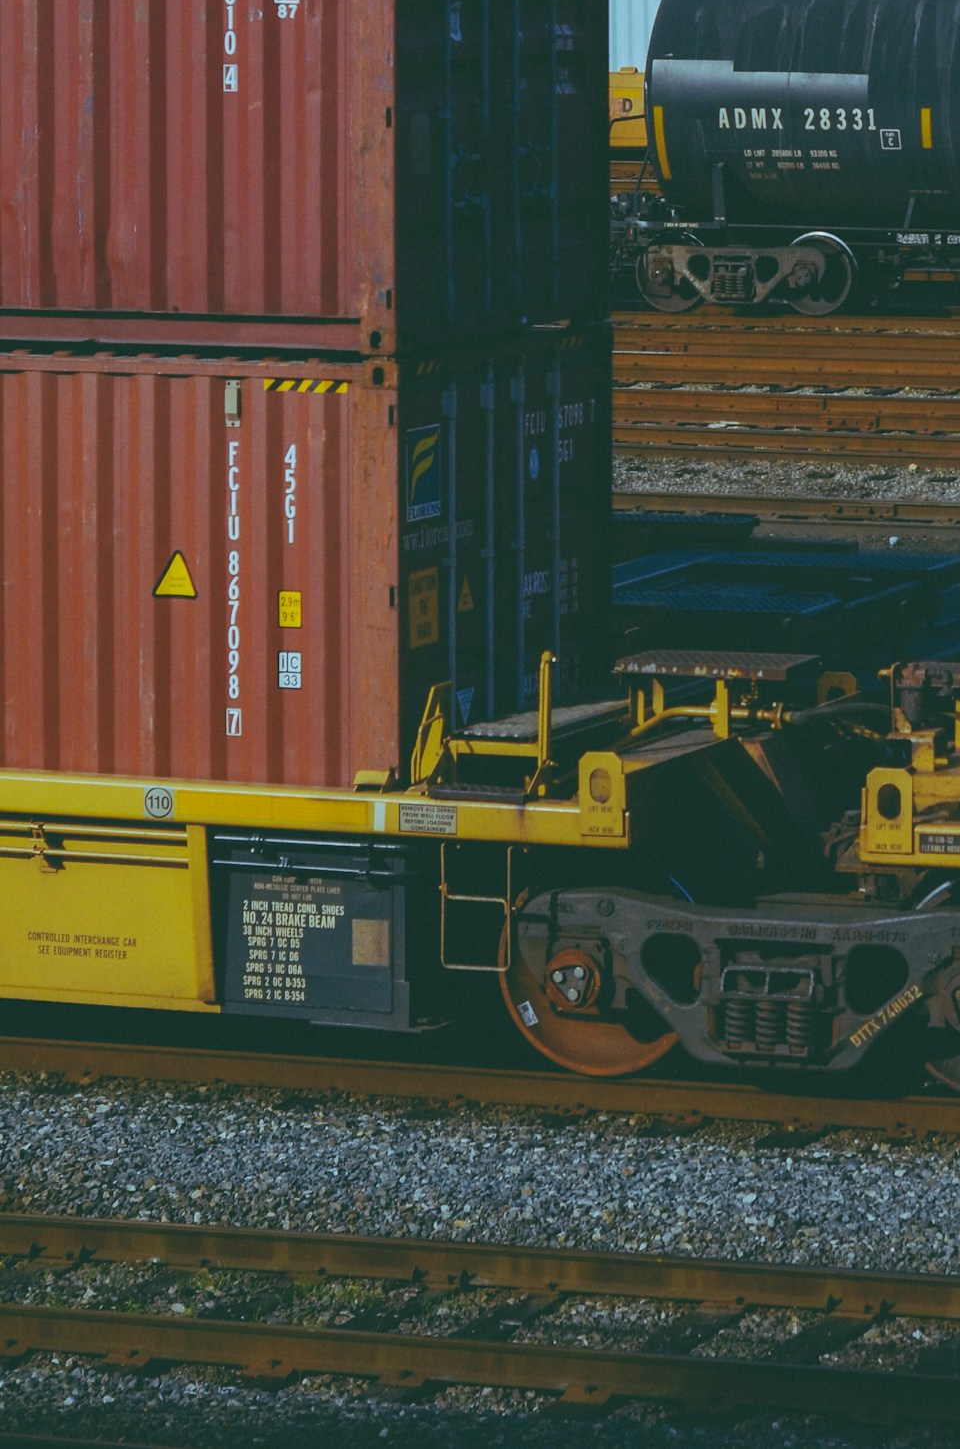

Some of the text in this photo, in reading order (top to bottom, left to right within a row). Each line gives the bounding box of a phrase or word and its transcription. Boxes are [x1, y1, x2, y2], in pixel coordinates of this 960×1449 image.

[277, 4, 297, 19] 87
[224, 65, 237, 91] 4
[622, 98, 633, 112] D
[718, 107, 877, 131] ADMX 28331
[888, 137, 894, 146] C
[558, 438, 573, 463] 5G1
[284, 444, 297, 543] 45G1
[228, 441, 240, 735] FCIU 867098 7
[283, 674, 298, 687] 33
[148, 795, 170, 810] 110
[243, 900, 344, 916] 2 INCH TREAD COND. SHOES
[243, 911, 335, 929] NO. 24 BRAKE BEAM
[243, 925, 304, 938] 38 INCH WHEELS
[28, 931, 136, 947] CONTROLLED INTERCHANGE CAR
[248, 937, 266, 947] SPRG
[270, 938, 274, 947] 7
[37, 945, 127, 959] SEE EQUIPMENT REGISTER
[249, 950, 267, 960] SPRG
[271, 951, 275, 960] 7
[279, 951, 286, 961] IC
[246, 962, 264, 973] SPRG
[267, 963, 272, 973] 5
[276, 964, 285, 974] IIC
[243, 975, 261, 986] SPRG
[265, 976, 269, 986] 2
[286, 978, 306, 989] B-353
[245, 988, 305, 1001] SPRG 2 IC B-354
